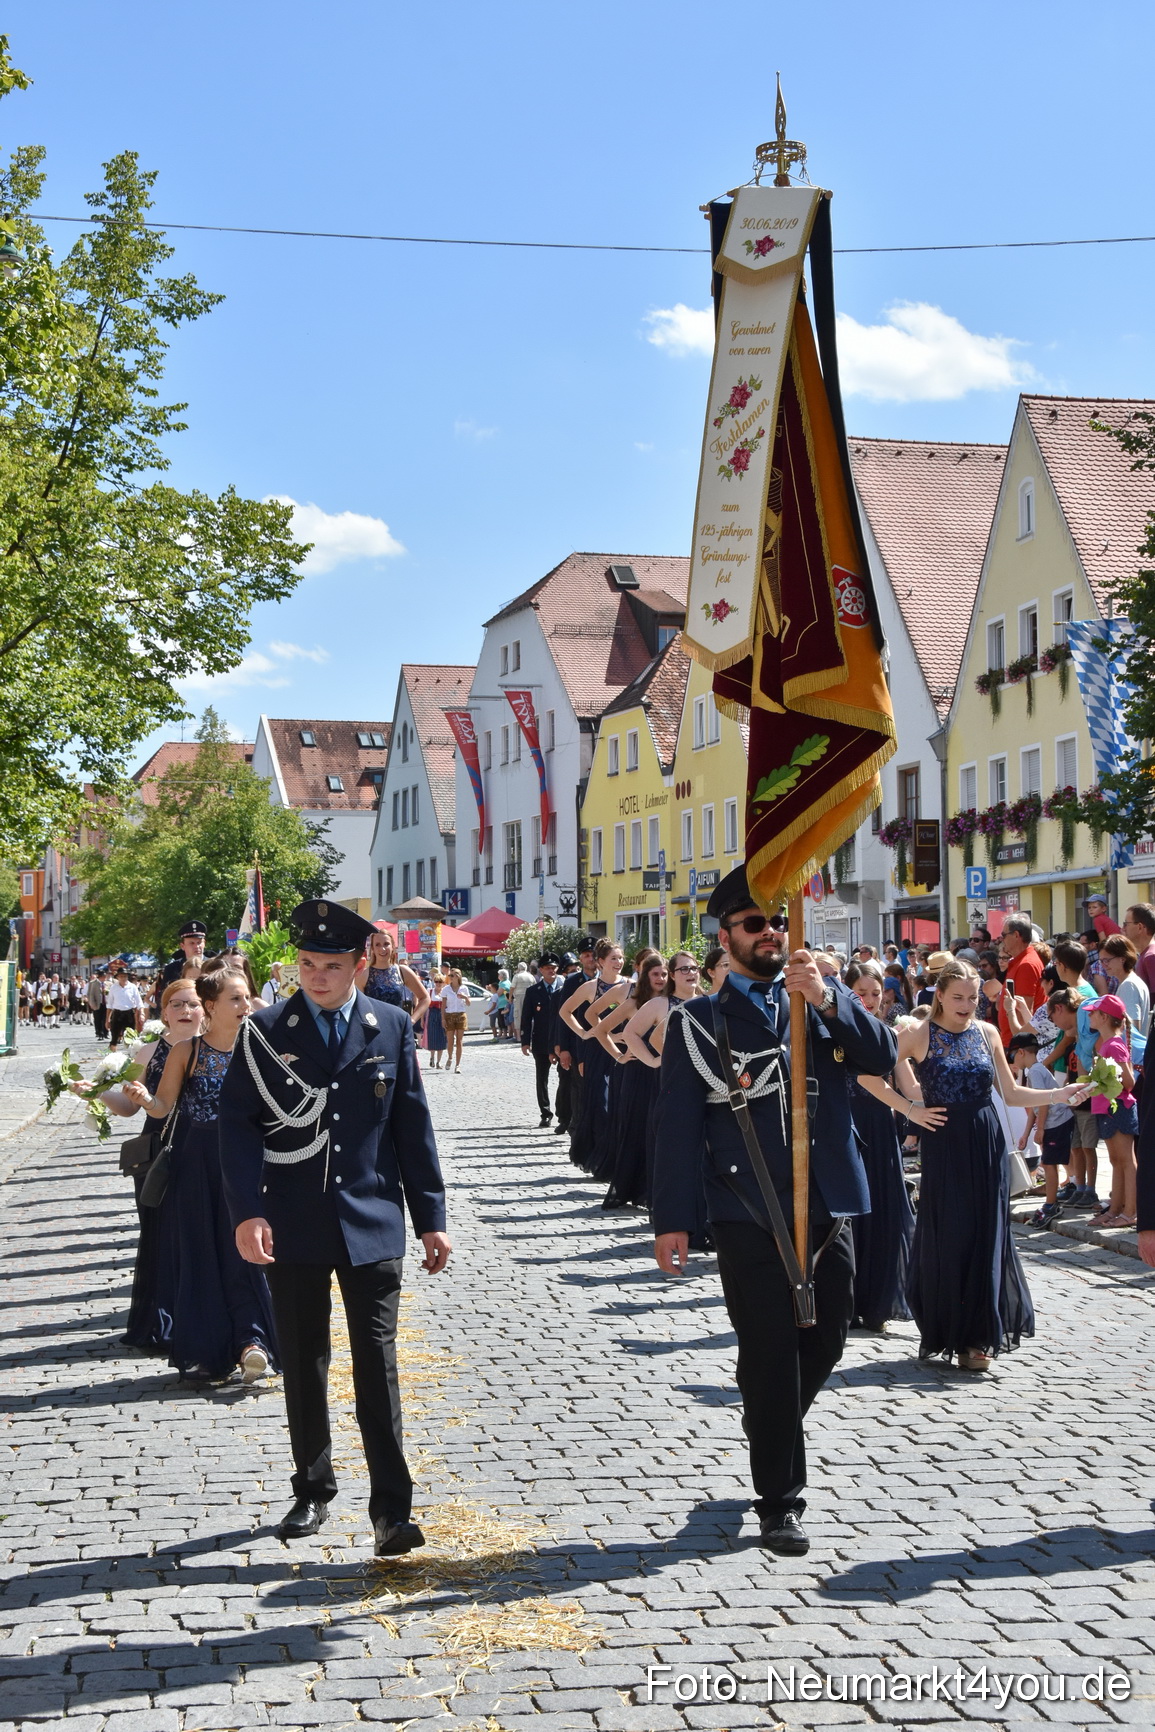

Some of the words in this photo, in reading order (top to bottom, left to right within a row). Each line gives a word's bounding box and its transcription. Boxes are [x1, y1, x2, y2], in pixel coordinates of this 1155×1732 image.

[739, 217, 799, 231] 30.06.2019
[730, 320, 776, 341] Gewidmet
[728, 346, 745, 356] von
[747, 345, 771, 356] euren
[709, 398, 770, 461] Festdamen
[720, 503, 740, 513] zum
[700, 522, 753, 542] 125-jährigen
[700, 545, 751, 567] Gründungs-
[715, 569, 732, 587] fest
[619, 795, 640, 816] HOTEL
[1012, 847, 1025, 858] MEHR
[690, 872, 695, 893] P
[697, 872, 715, 887] AIFUN
[970, 871, 983, 895] P
[617, 892, 647, 907] Restaurant
